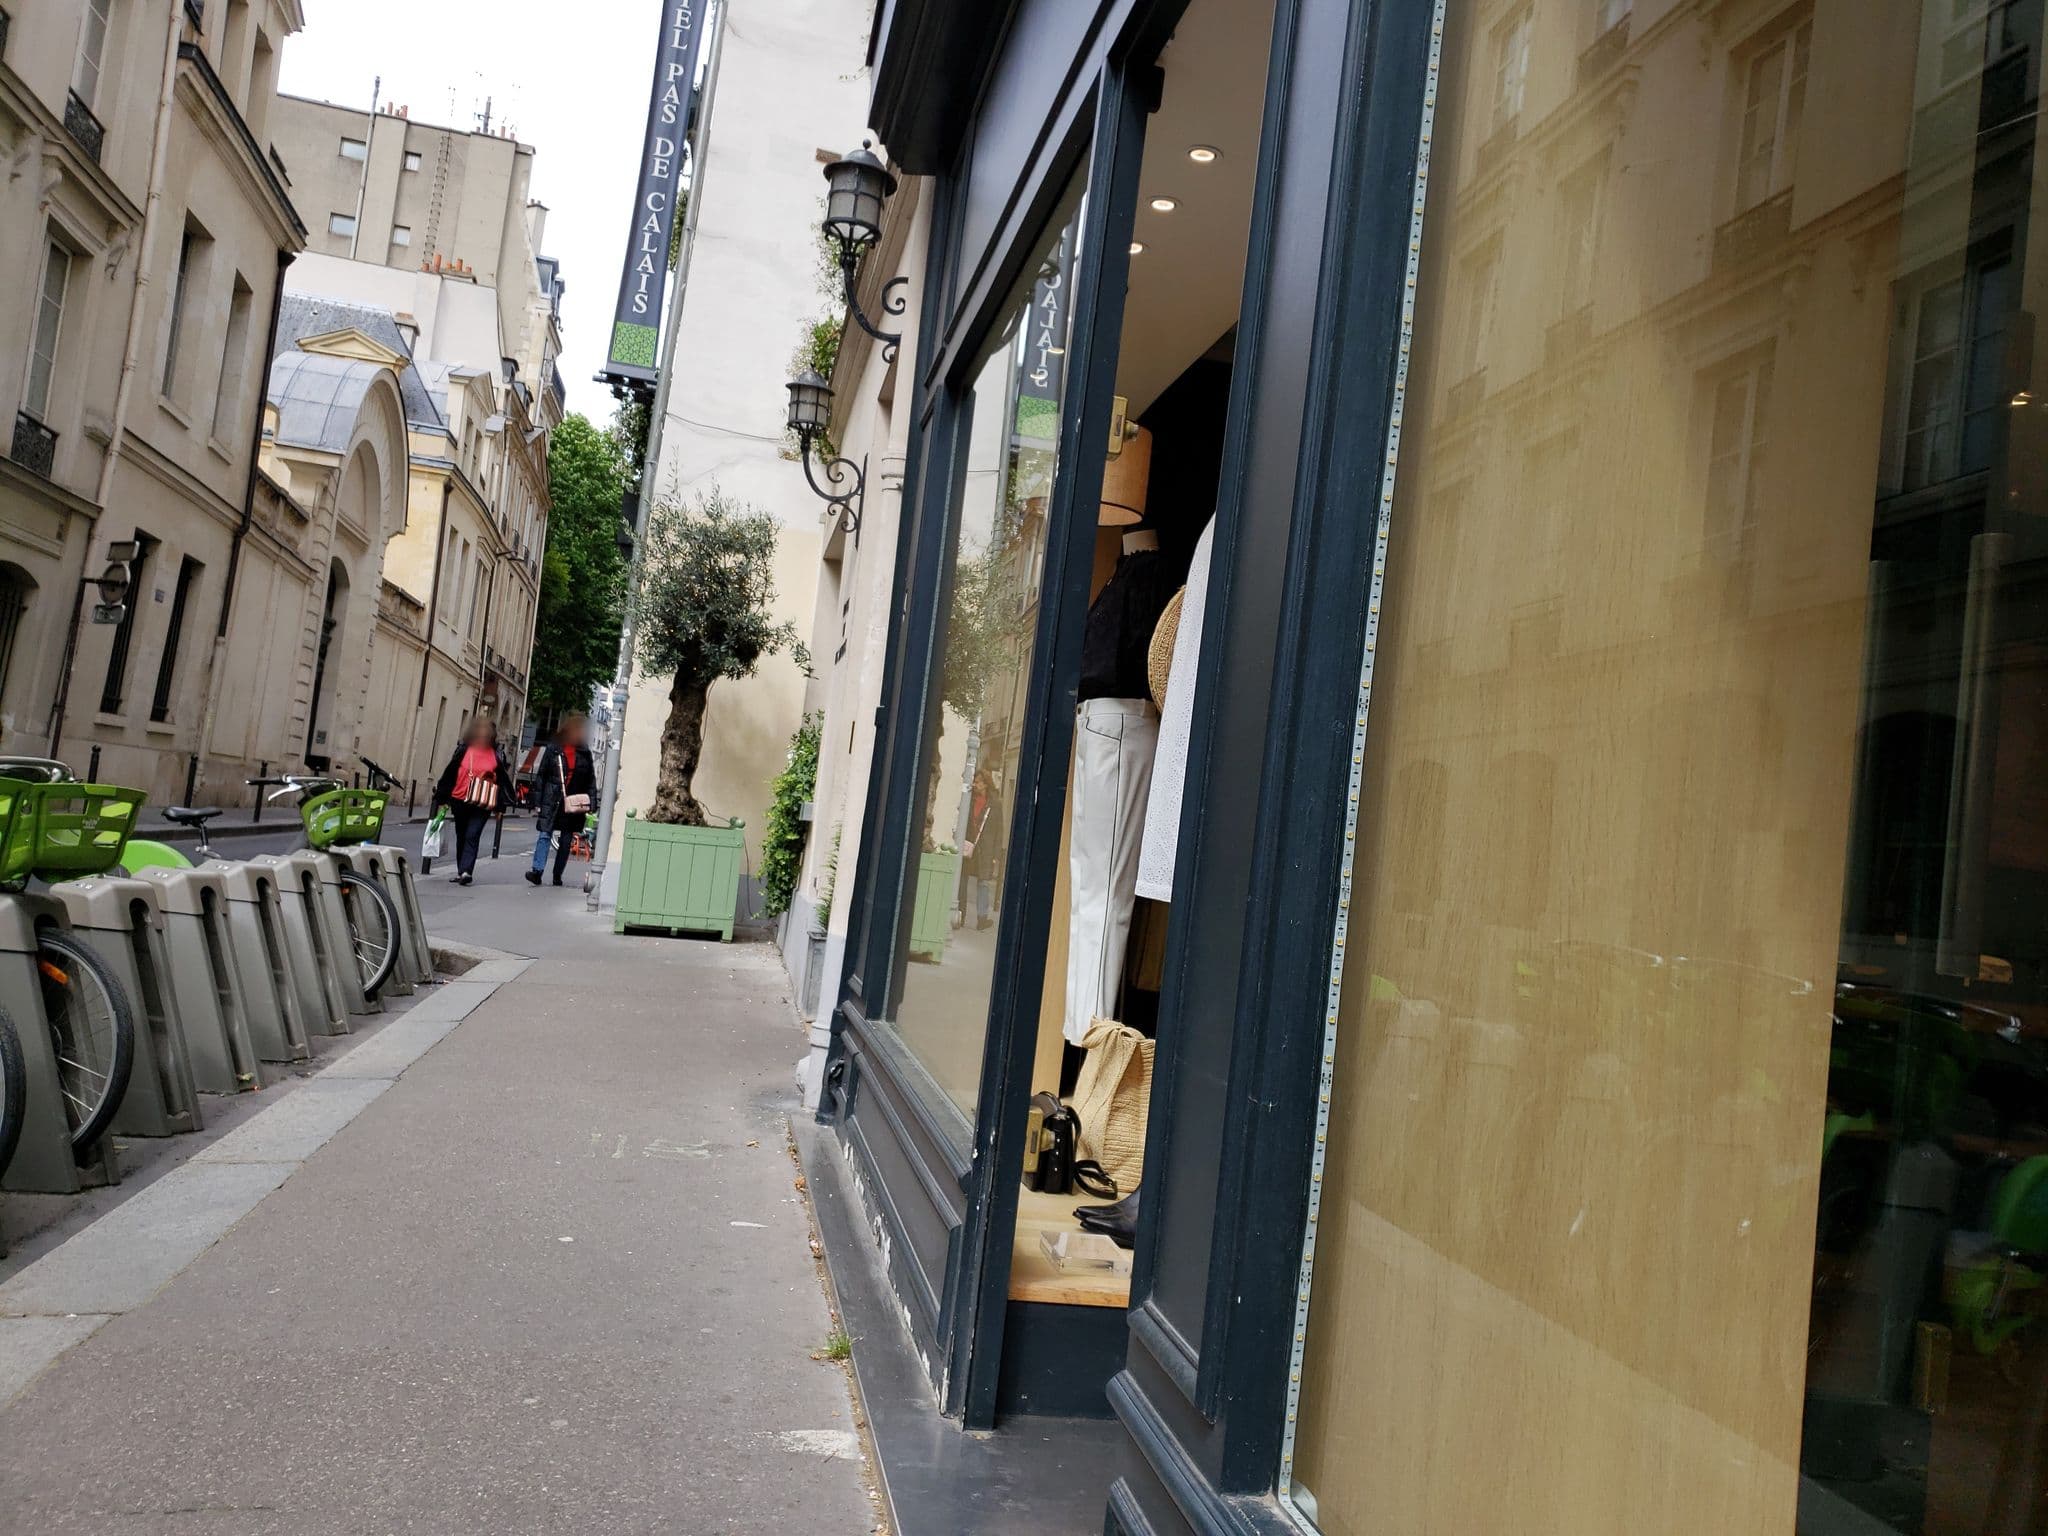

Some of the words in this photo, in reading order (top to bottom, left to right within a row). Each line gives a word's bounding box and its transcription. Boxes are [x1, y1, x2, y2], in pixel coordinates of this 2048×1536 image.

[661, 62, 685, 124] PAS
[651, 136, 675, 179] DE
[632, 191, 666, 314] CALAIS
